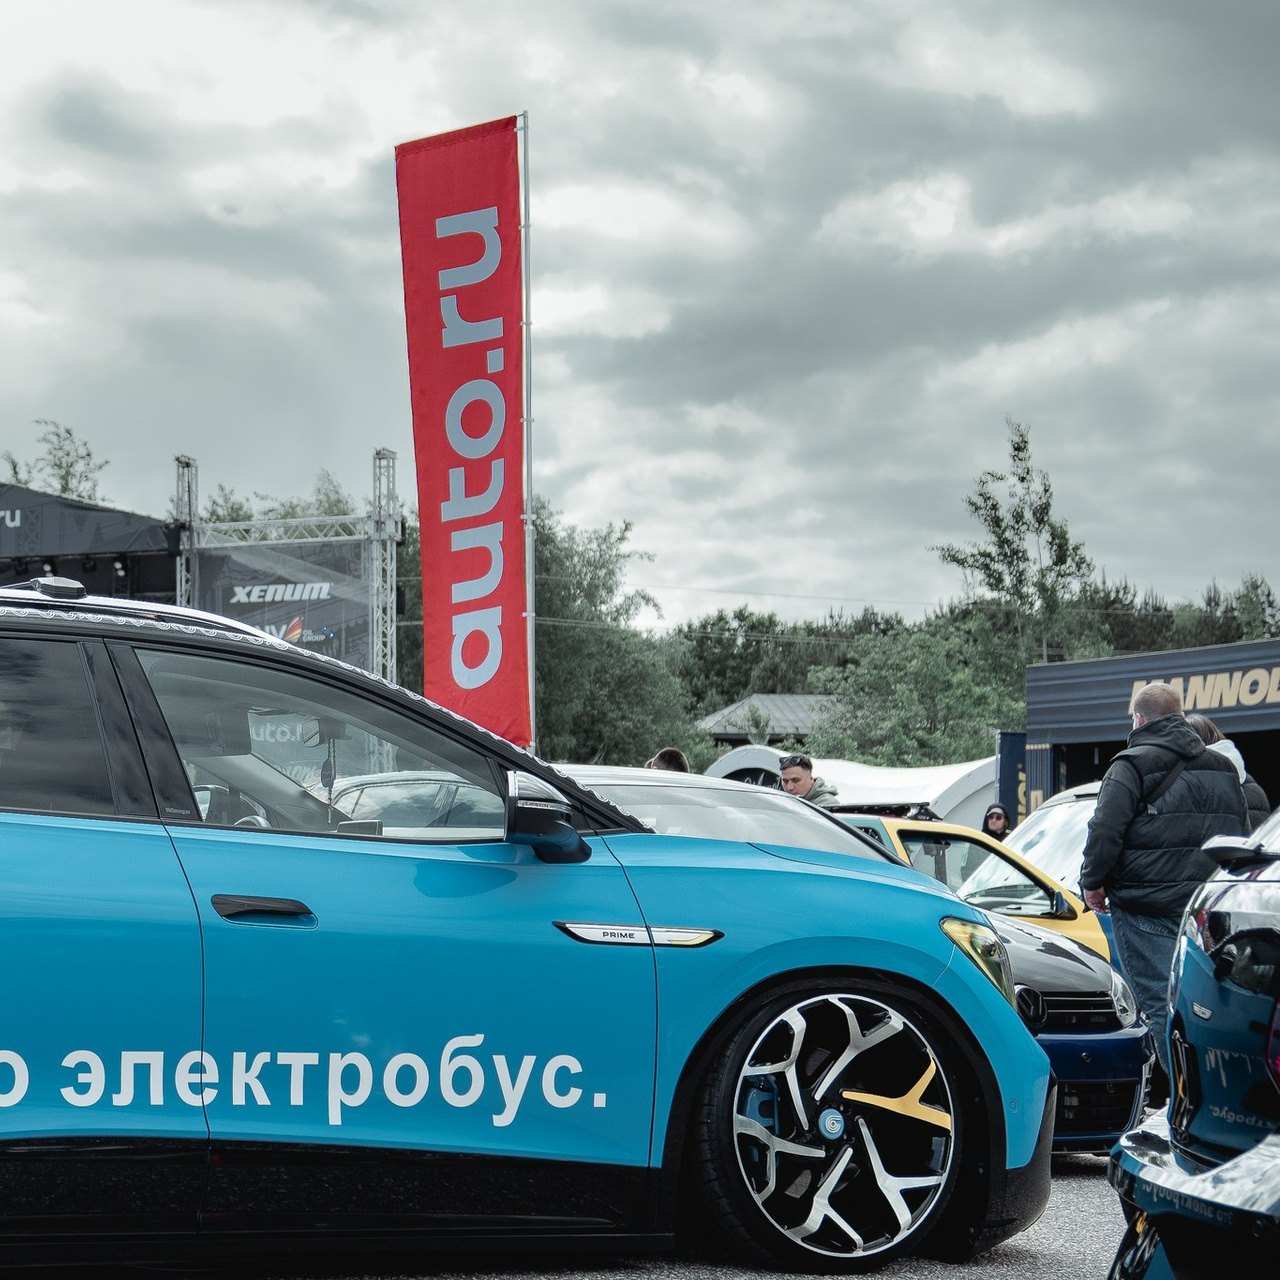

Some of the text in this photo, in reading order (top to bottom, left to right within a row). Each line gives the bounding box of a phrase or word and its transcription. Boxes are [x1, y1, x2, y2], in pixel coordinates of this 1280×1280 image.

[434, 205, 506, 690] auto.ru
[229, 582, 331, 604] XENUM
[302, 634, 326, 642] GROUP
[602, 931, 635, 939] PRIME
[59, 1033, 606, 1127] электробус.
